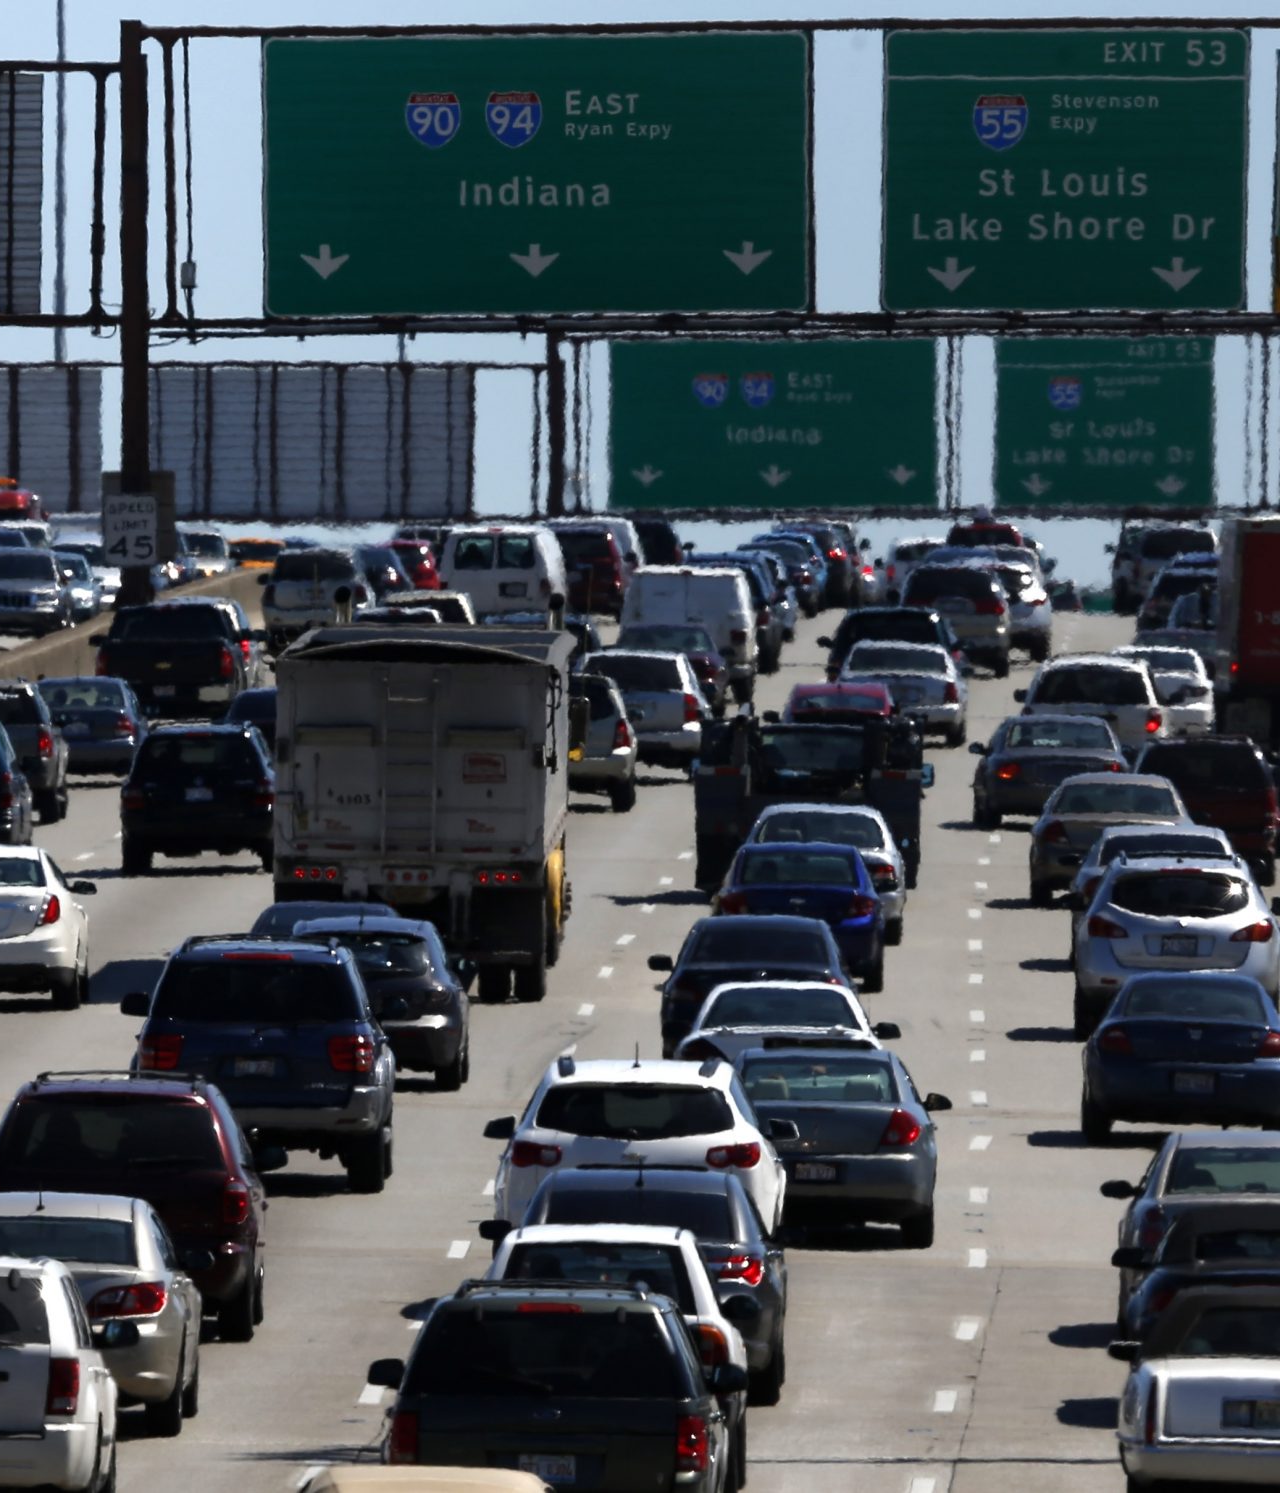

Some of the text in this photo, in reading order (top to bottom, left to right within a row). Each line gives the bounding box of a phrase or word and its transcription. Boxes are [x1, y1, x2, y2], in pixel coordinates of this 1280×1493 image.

[1103, 39, 1227, 67] EXIT 53
[565, 89, 640, 116] EAST
[1051, 93, 1160, 109] Stevenson
[412, 106, 454, 136] 90
[490, 105, 535, 135] 94
[564, 122, 673, 141] Ryan Expy
[981, 109, 1022, 140] 55
[1049, 115, 1098, 134] Expy
[459, 175, 612, 208] Indiana
[978, 166, 1149, 198] St Louis
[912, 211, 1217, 241] Lake Shore Dr
[1054, 385, 1080, 404] 55
[726, 424, 824, 445] Indiana
[1088, 417, 1156, 439] Louis
[1012, 447, 1067, 465] Lake
[1083, 446, 1155, 465] Shore
[108, 502, 155, 515] SPEED
[113, 519, 148, 532] LIMIT
[107, 535, 154, 560] 45
